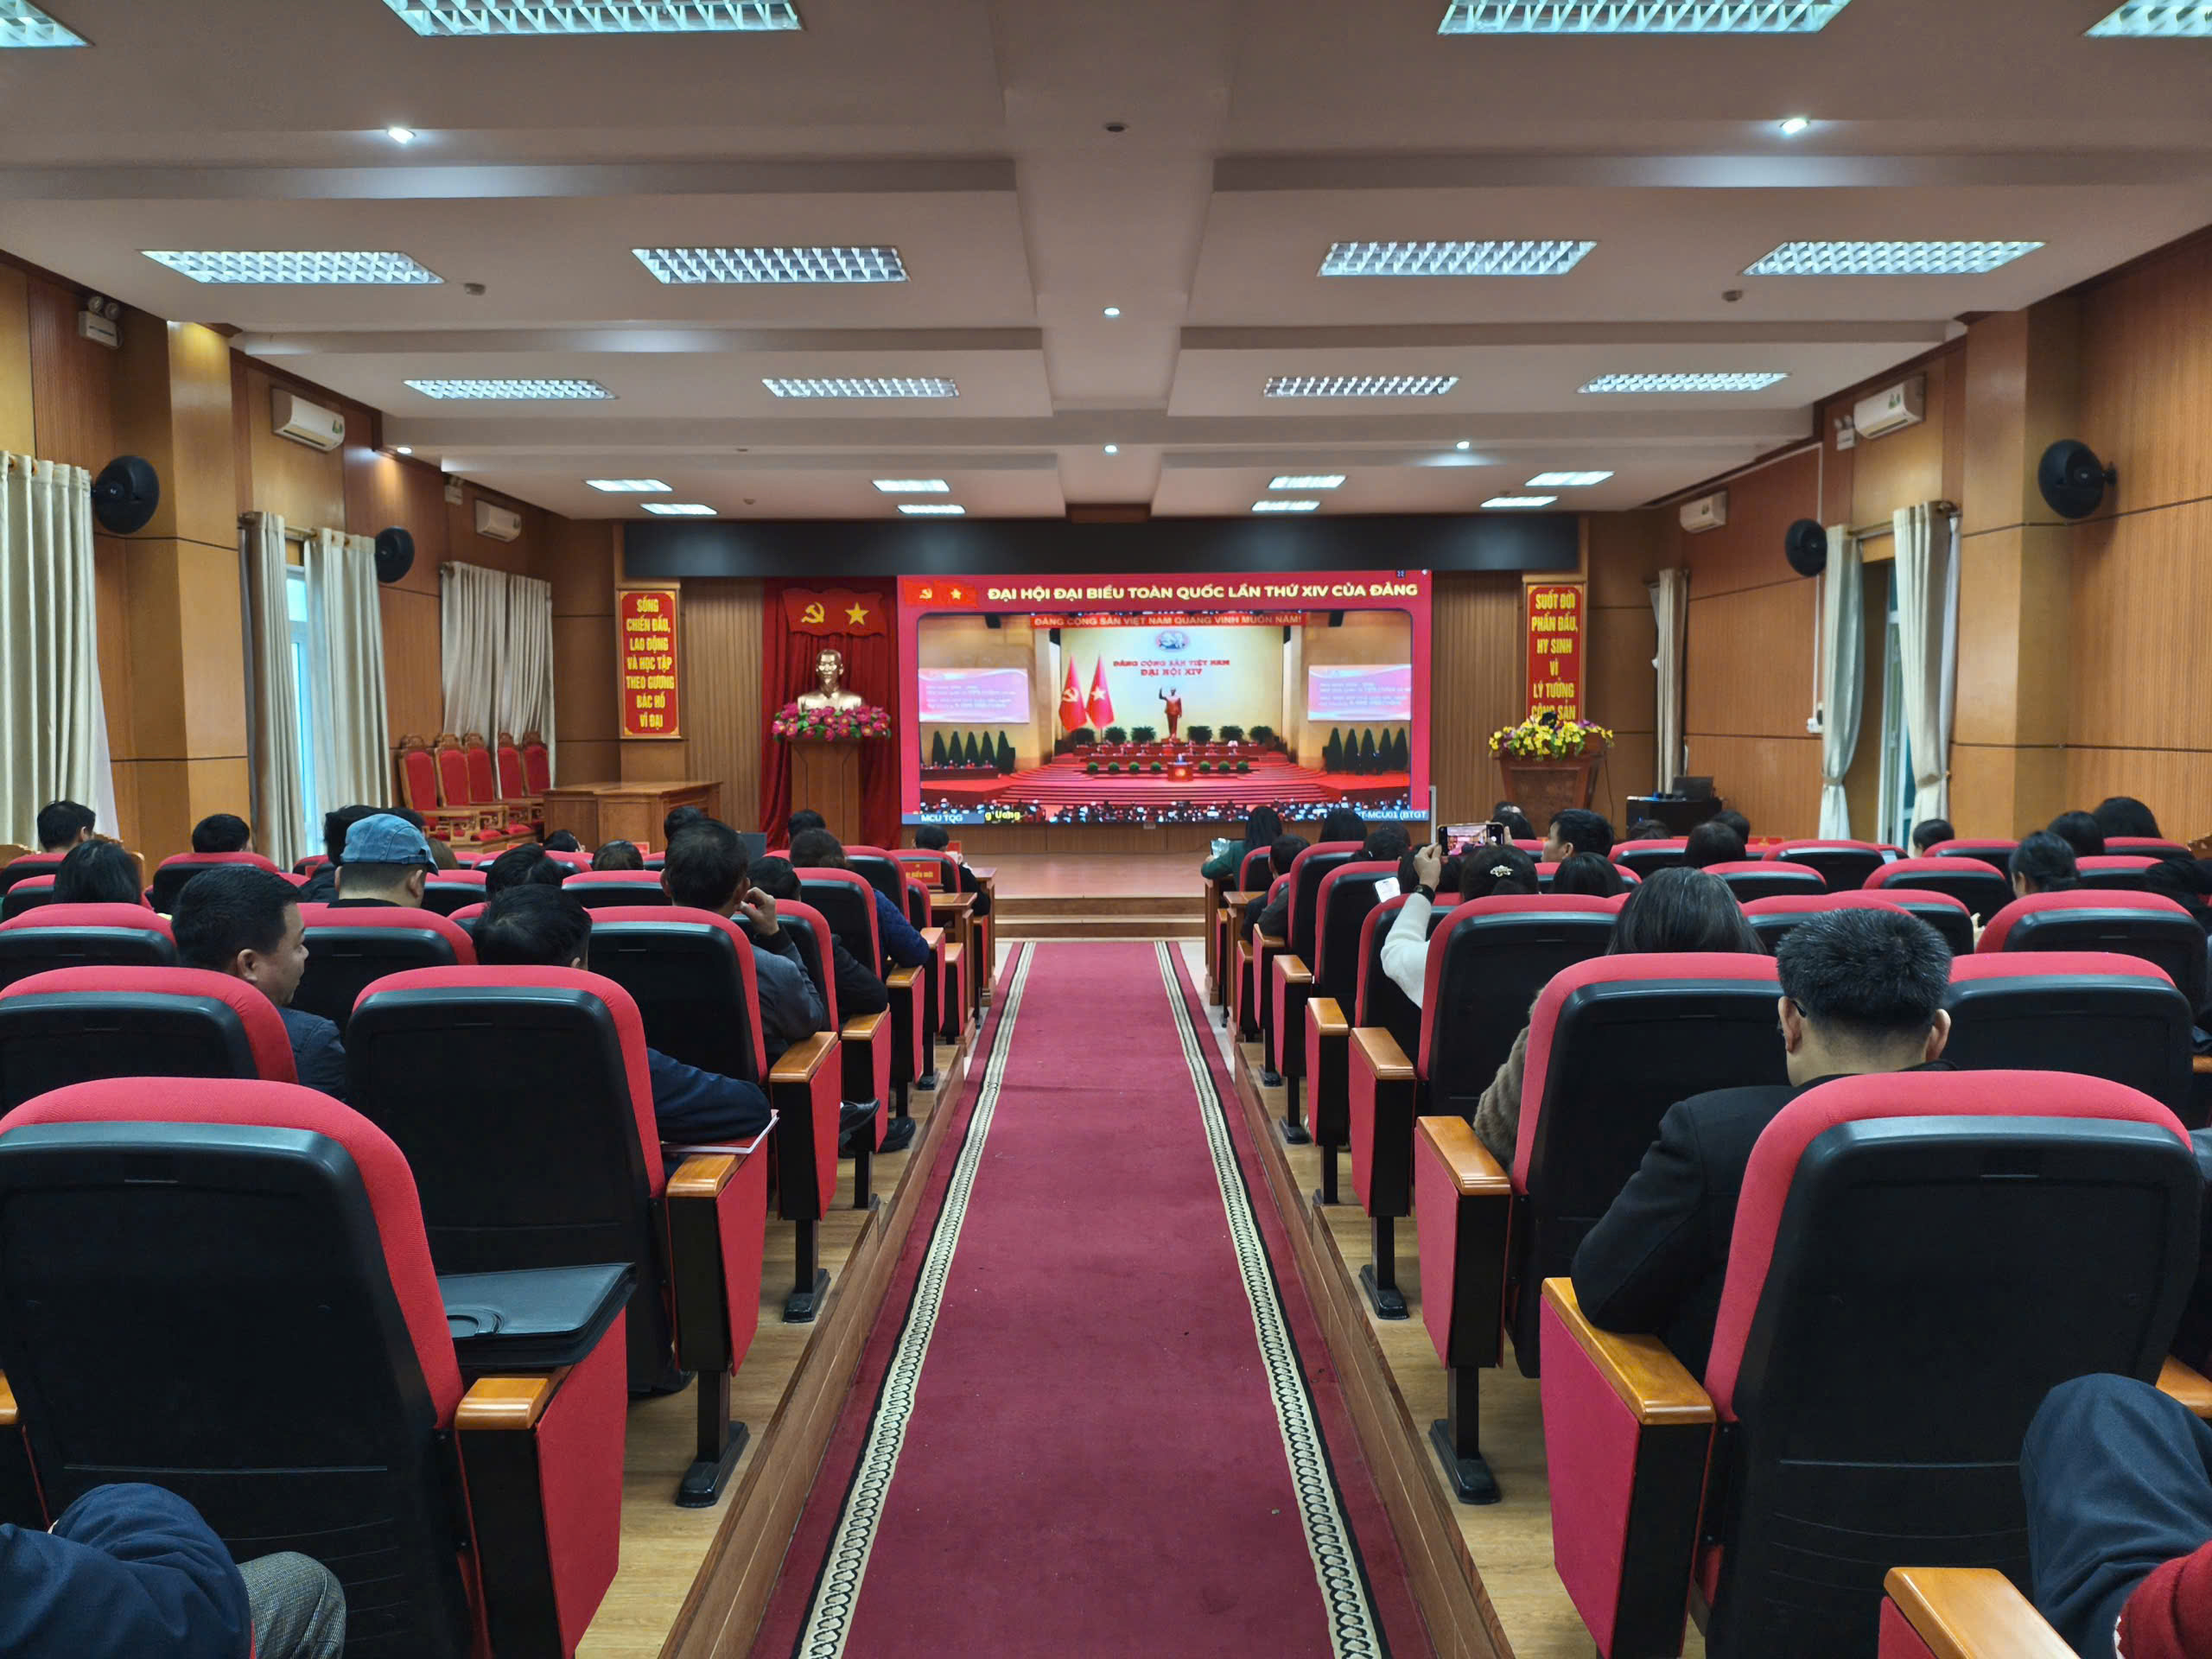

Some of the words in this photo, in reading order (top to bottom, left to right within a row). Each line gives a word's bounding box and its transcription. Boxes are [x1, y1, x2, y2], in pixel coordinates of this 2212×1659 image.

[988, 588, 1016, 602] ĐẠI
[1020, 586, 1051, 602] HỘI
[1053, 588, 1083, 602] ĐẠI
[1086, 584, 1124, 599] BIỂU
[1128, 585, 1173, 599] TOÀN
[1176, 584, 1224, 601] QUỐC
[1228, 583, 1261, 598] LẦN
[1264, 583, 1299, 597] THỨ
[1301, 585, 1329, 597] XIV
[1332, 582, 1367, 596] CỦA
[1370, 582, 1418, 596] ĐẢNG
[1033, 615, 1065, 626] ĐẢNG
[1066, 616, 1098, 626] CỘNG
[1100, 615, 1122, 626] SẢN
[1123, 615, 1146, 626] VIỆT
[1148, 616, 1173, 625] NAM
[1174, 616, 1211, 625] QUANG
[1550, 639, 1573, 654] SINH
[920, 813, 942, 823] MCU
